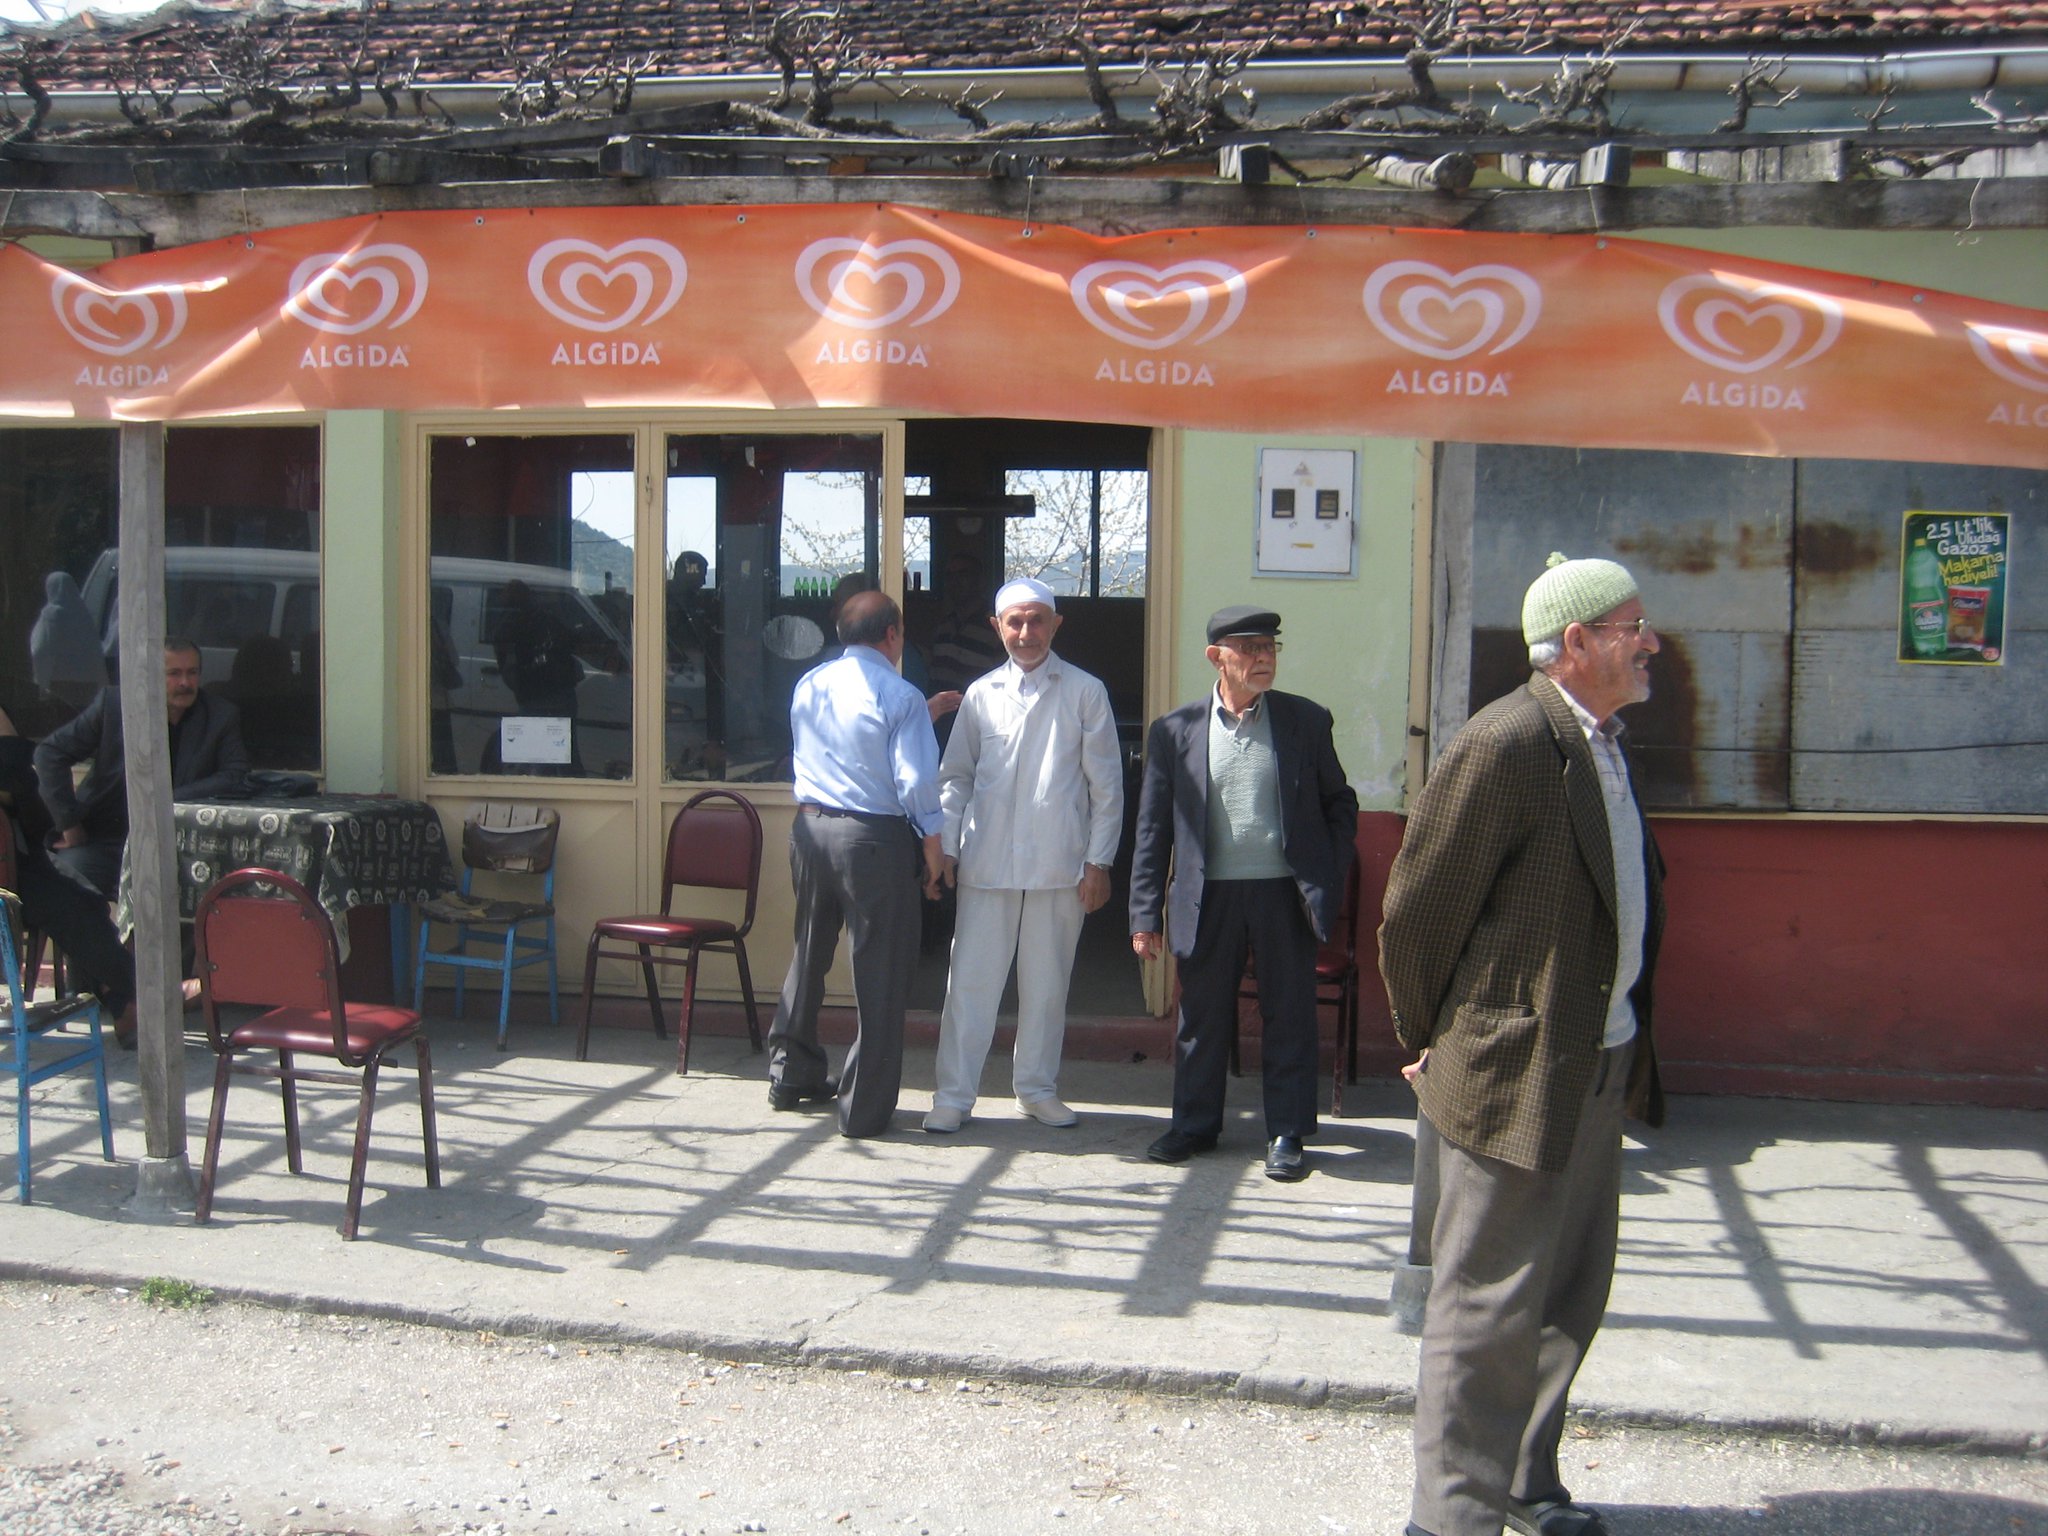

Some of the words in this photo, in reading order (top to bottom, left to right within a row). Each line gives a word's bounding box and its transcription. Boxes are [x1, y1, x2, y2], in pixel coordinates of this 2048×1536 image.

[1937, 540, 1989, 556] Gazoz
[1938, 552, 2004, 575] Makarna
[1944, 564, 1999, 586] hediyeli!
